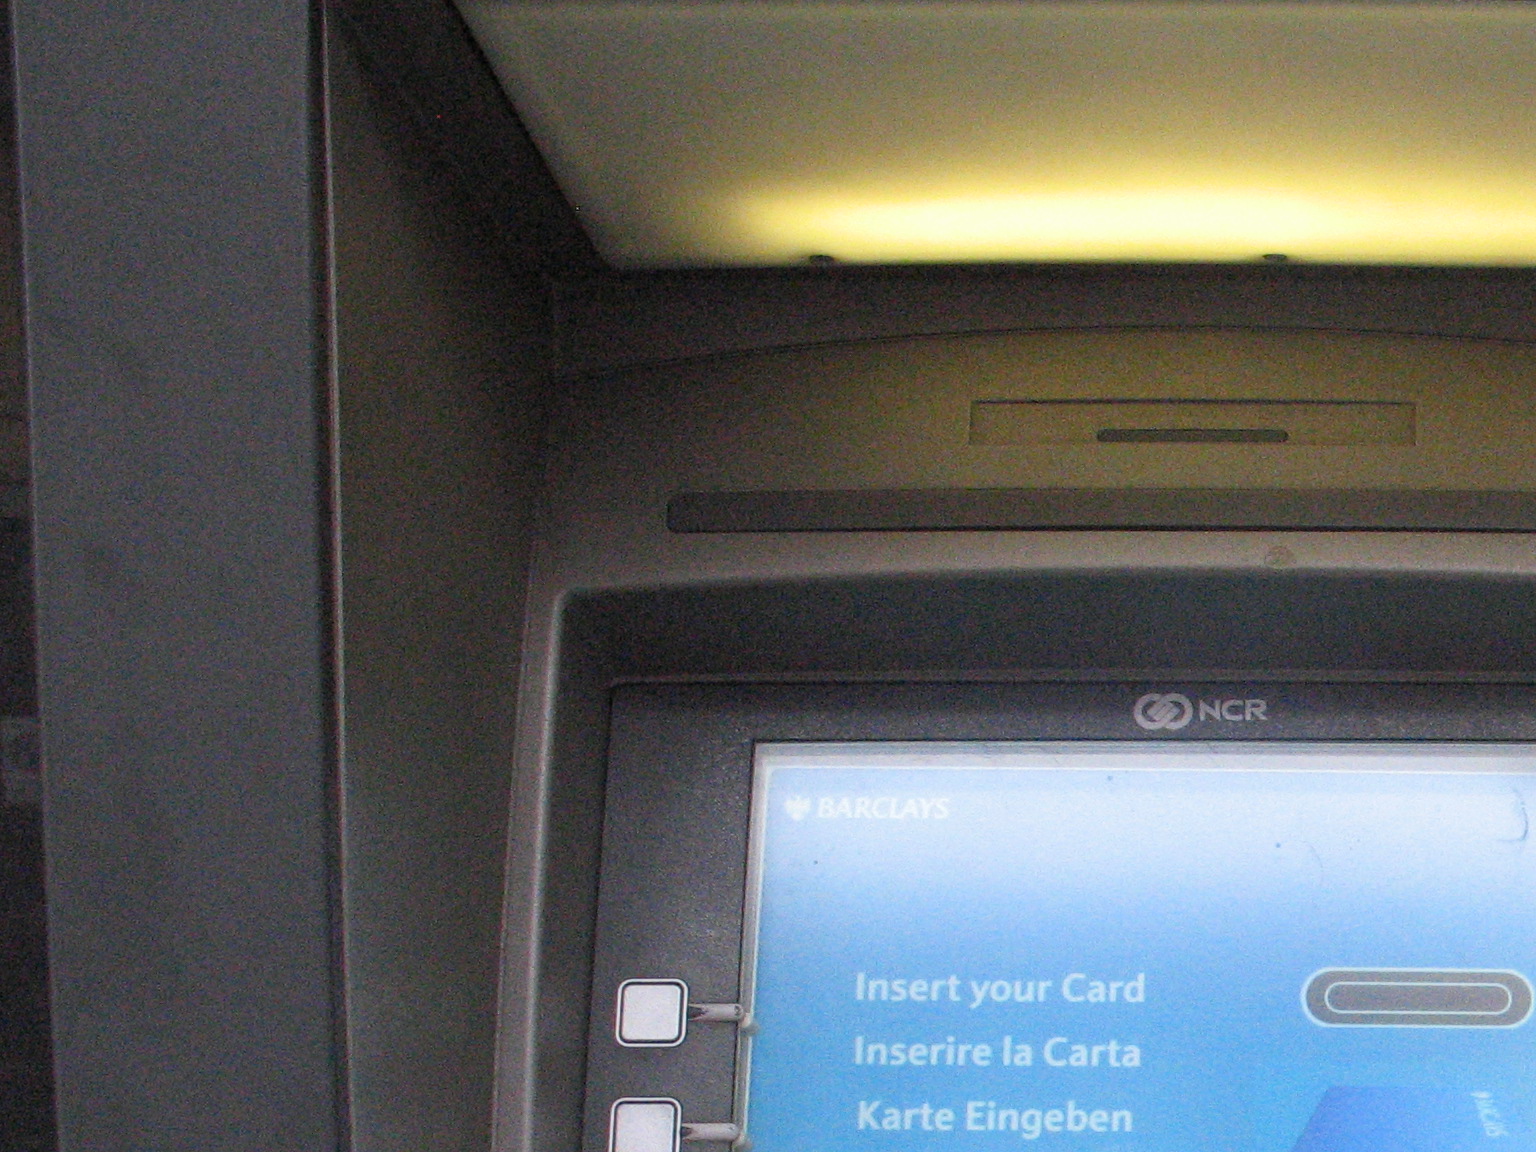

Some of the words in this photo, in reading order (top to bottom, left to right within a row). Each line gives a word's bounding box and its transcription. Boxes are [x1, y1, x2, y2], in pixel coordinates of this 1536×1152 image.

[1199, 699, 1268, 722] NCR
[817, 796, 950, 820] BARCLAYS
[855, 971, 961, 1002] Insert
[968, 977, 1052, 1009] your
[1061, 972, 1146, 1003] Card
[853, 1035, 992, 1066] Inserire
[1001, 1035, 1033, 1067] la
[1043, 1036, 1142, 1068] Carta
[857, 1100, 956, 1131] Karte
[965, 1100, 1134, 1140] Eingeben
